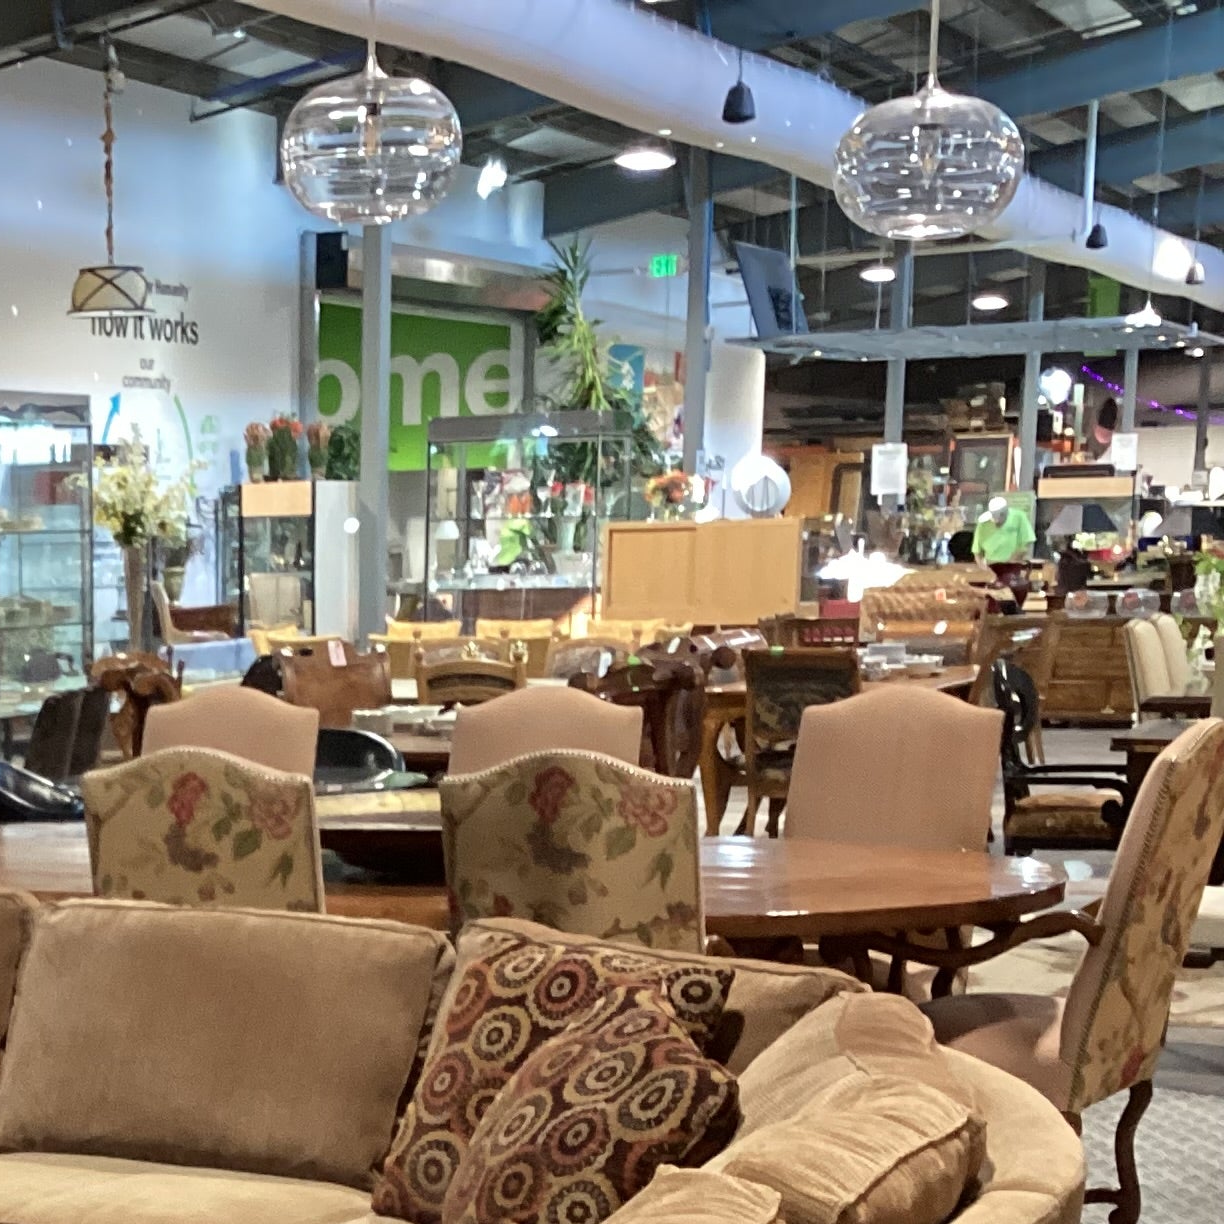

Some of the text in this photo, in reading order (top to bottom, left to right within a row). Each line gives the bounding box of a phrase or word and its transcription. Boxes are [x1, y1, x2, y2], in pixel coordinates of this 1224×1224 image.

[652, 255, 678, 278] EXIT
[149, 311, 199, 345] works
[139, 357, 155, 370] our
[122, 373, 171, 394] community
